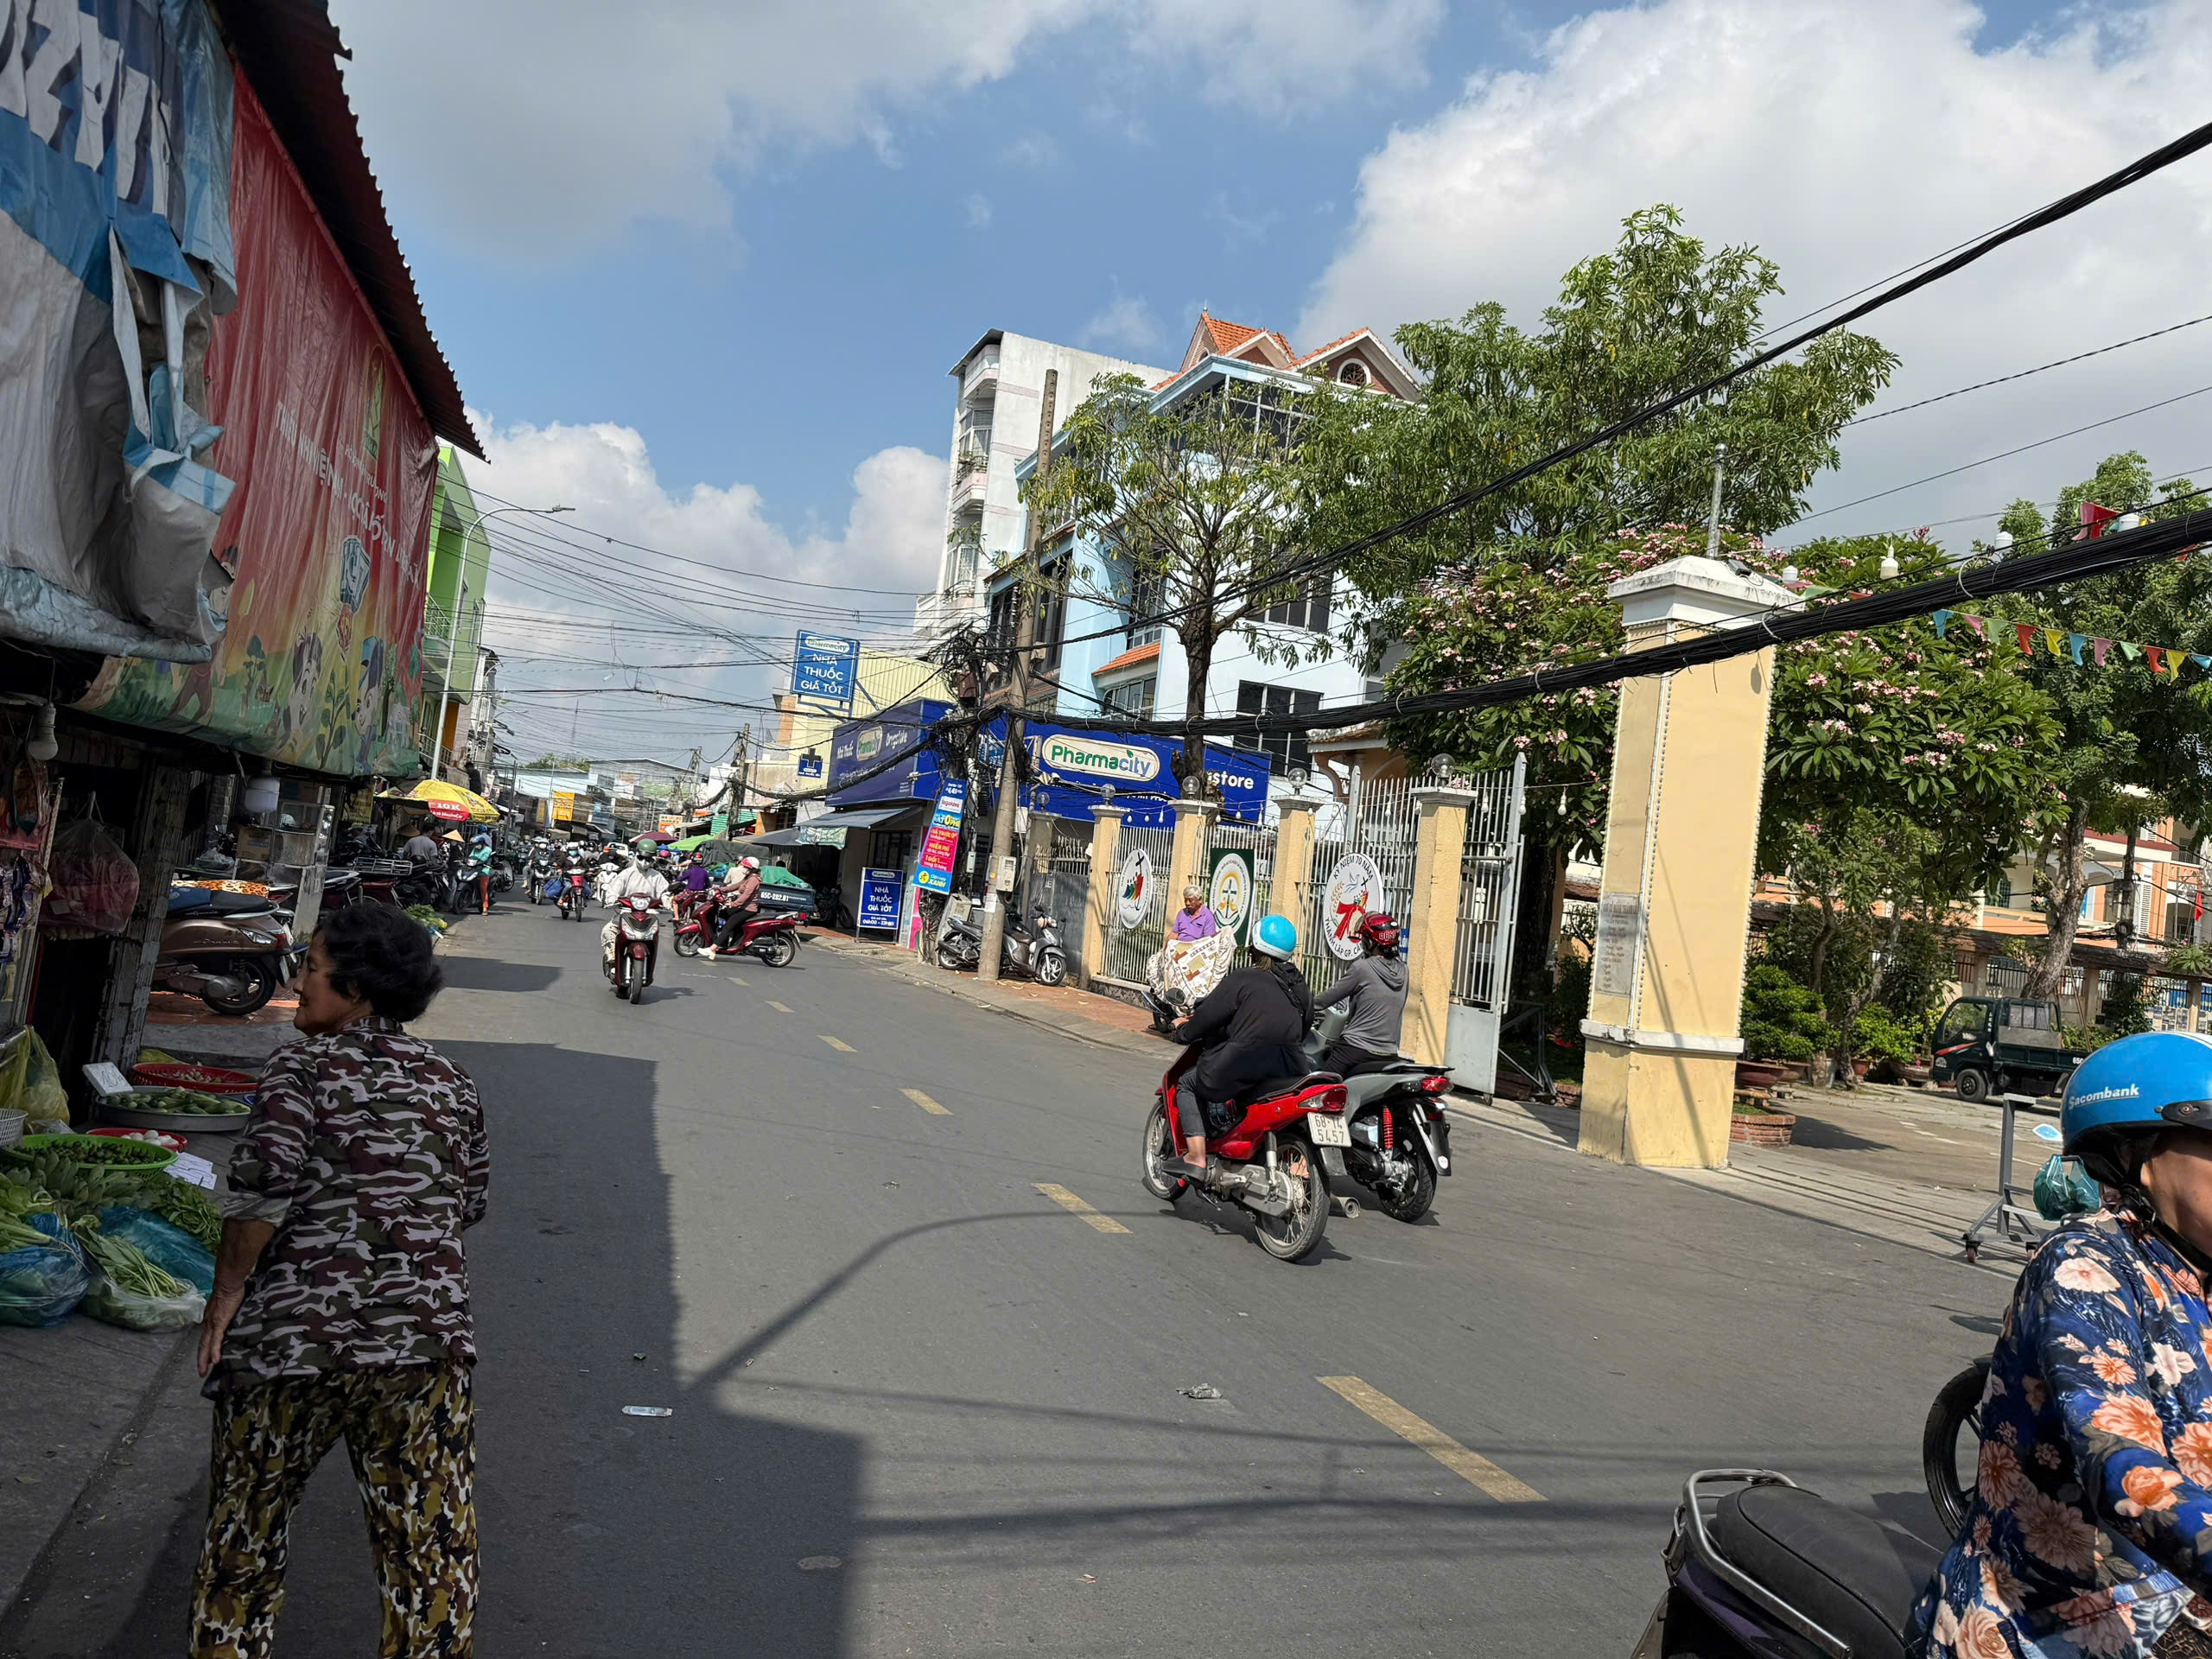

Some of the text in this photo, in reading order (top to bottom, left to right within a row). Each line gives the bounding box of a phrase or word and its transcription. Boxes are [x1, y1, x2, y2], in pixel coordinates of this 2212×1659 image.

[804, 666, 843, 680] THUỐC
[801, 680, 843, 694] GIÁ TỐT
[1052, 745, 1150, 777] Pharmacity
[870, 894, 893, 903] THUỐC
[880, 904, 893, 912] TỐT
[2069, 1084, 2139, 1109] Sacombank
[1318, 1129, 1344, 1143] 5457
